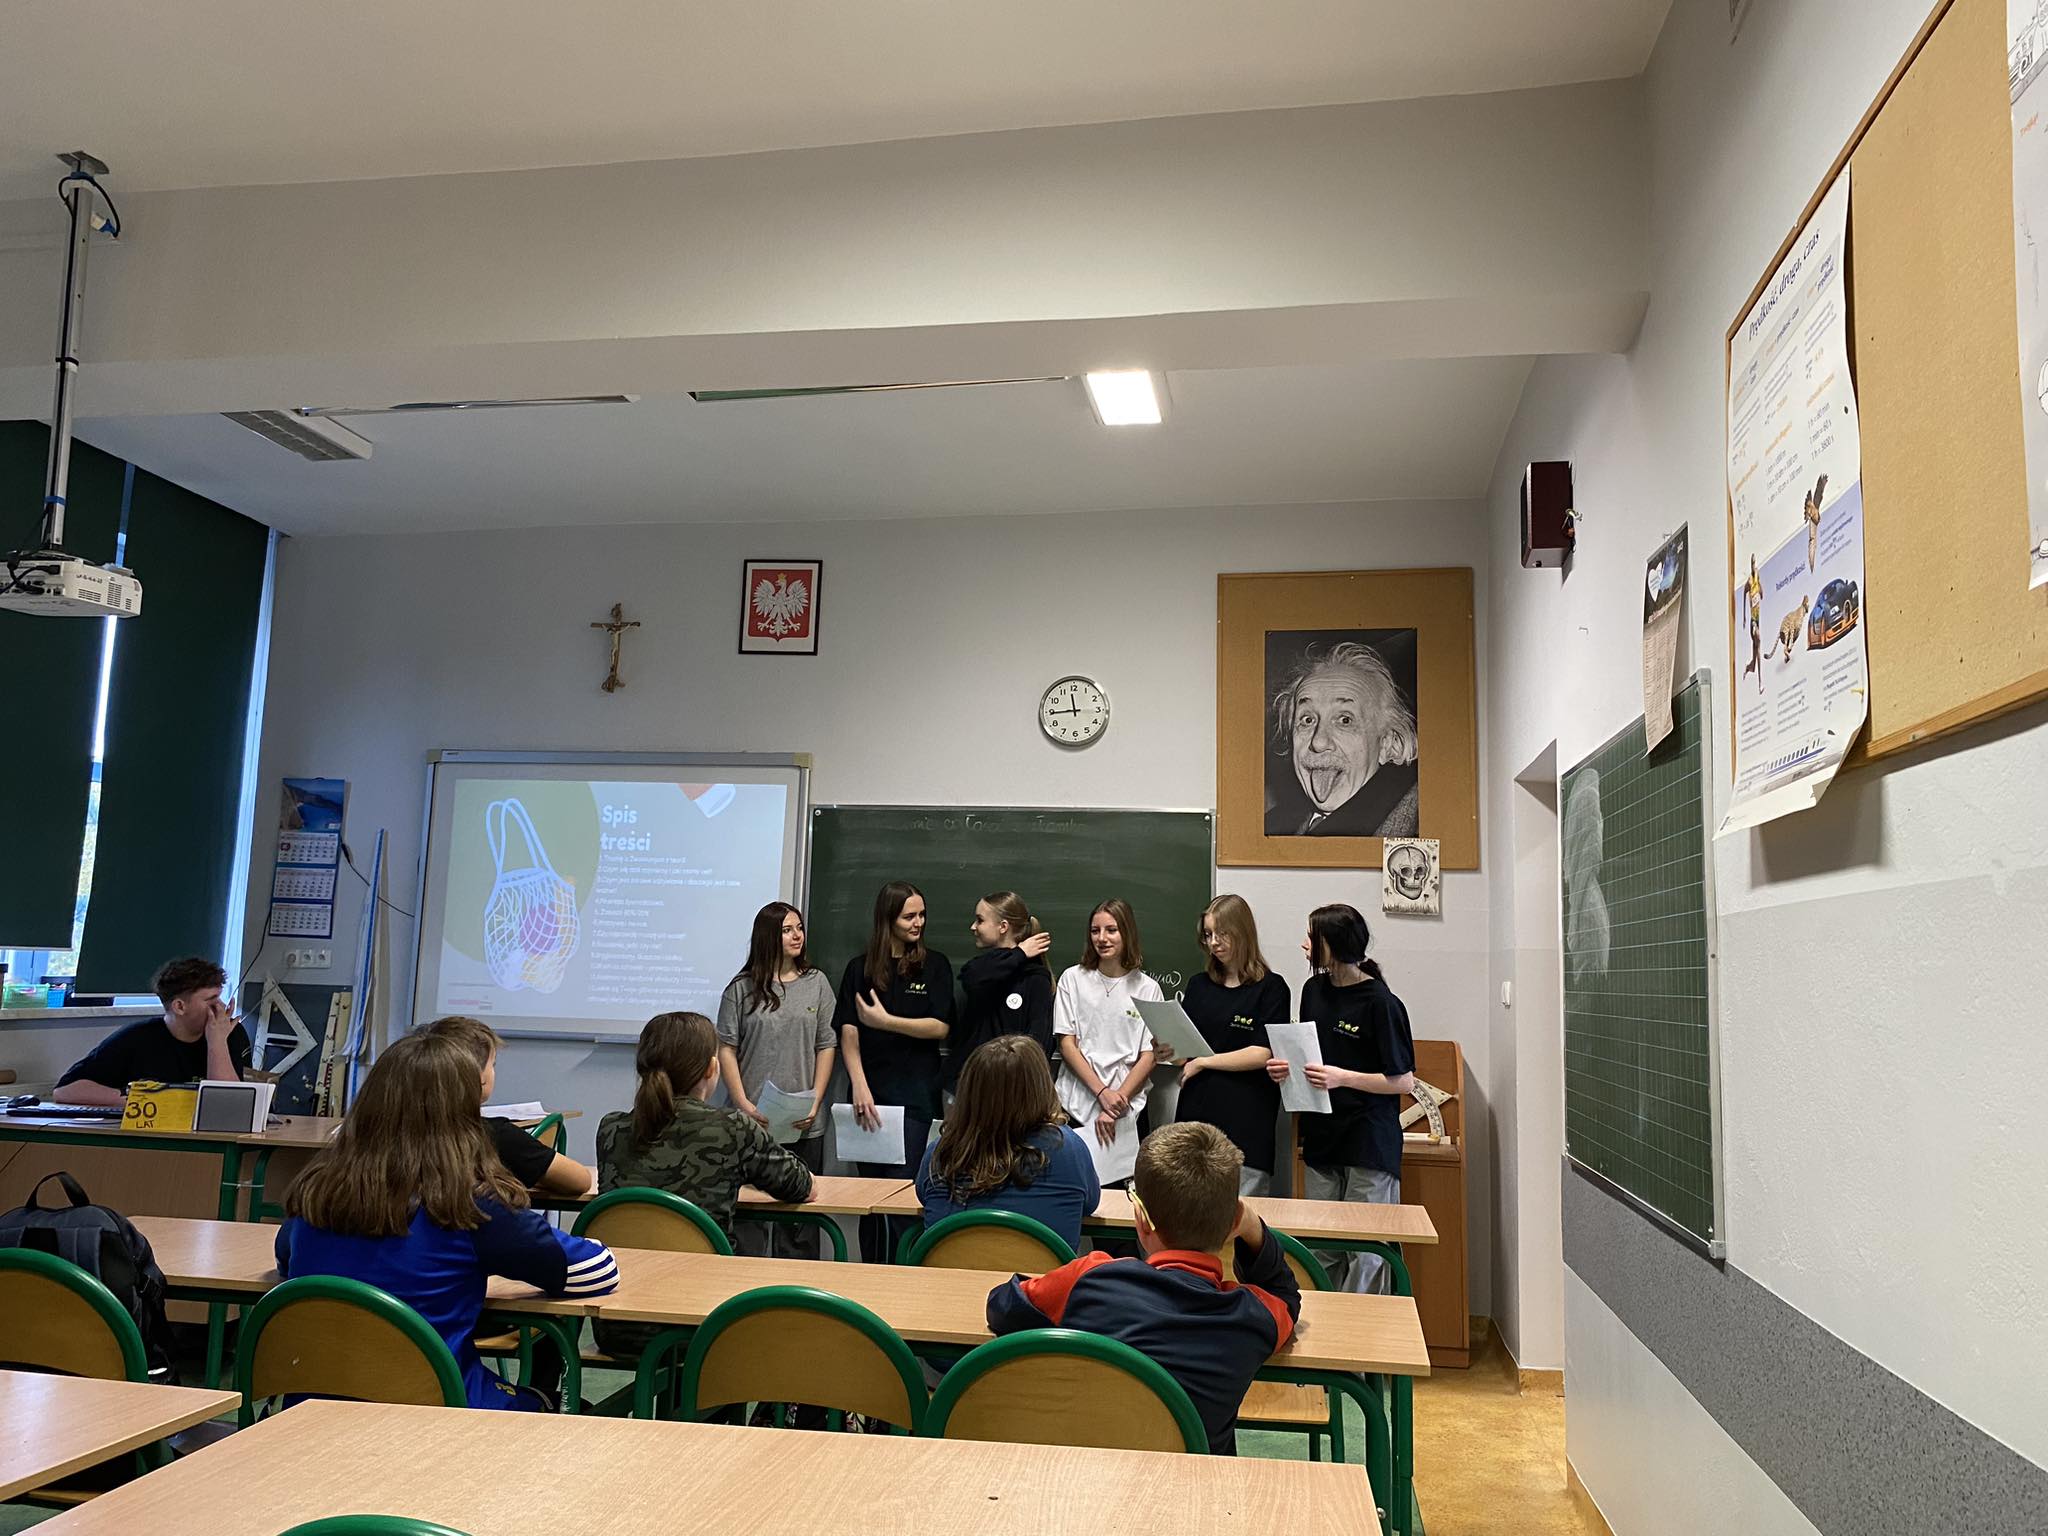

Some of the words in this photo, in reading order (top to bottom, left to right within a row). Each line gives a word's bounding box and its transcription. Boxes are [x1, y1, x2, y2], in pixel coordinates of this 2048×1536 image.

[602, 804, 638, 828] Spis
[600, 830, 652, 852] treści
[126, 1101, 157, 1119] 30
[136, 1120, 154, 1129] LAT
